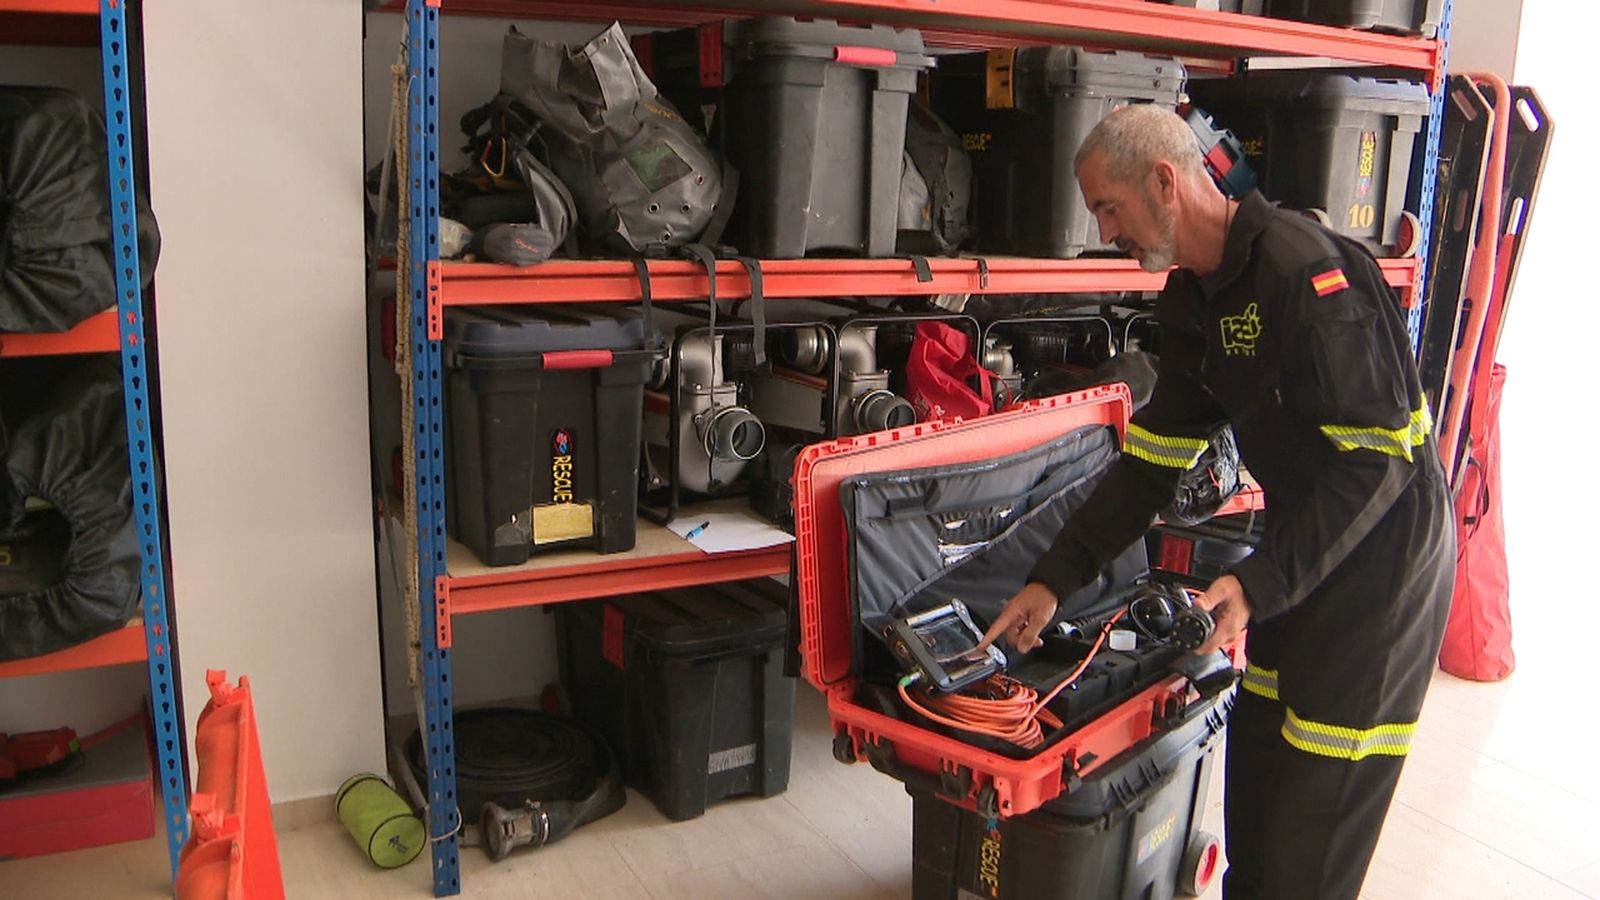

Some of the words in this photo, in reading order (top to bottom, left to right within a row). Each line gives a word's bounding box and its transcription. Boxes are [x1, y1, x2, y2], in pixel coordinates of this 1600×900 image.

[1359, 140, 1376, 177] RESCUE
[1349, 203, 1375, 229] 10
[553, 455, 573, 504] RESCUE
[980, 837, 1001, 887] RESCUE
